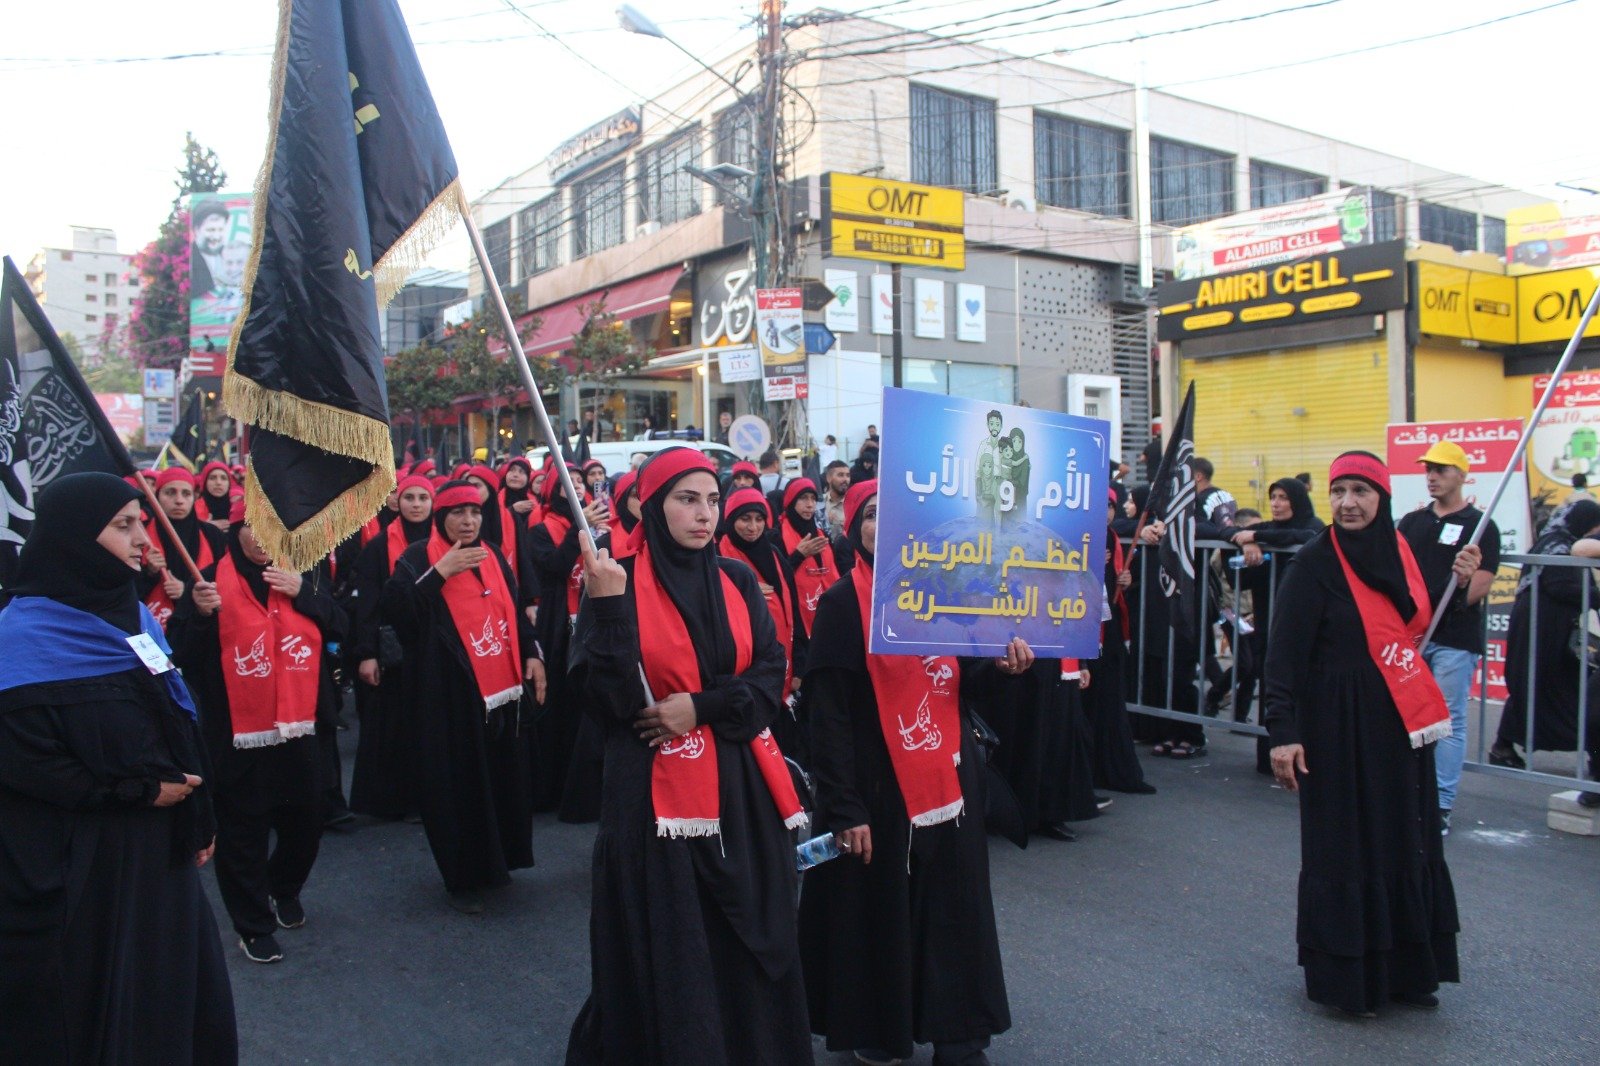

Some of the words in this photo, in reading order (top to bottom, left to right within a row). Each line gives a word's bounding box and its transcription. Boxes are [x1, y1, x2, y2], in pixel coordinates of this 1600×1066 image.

[868, 185, 929, 215] OMT
[1225, 239, 1283, 262] ALAMIRI
[1287, 231, 1322, 249] CELL
[1195, 270, 1268, 308] AMIRI
[1272, 257, 1349, 295] CELL
[1424, 287, 1461, 313] OMT
[1533, 287, 1600, 323] OM
[905, 443, 970, 502] الأب
[999, 479, 1017, 512] و
[901, 532, 992, 571] المربين
[1001, 532, 1091, 578] أعظم
[897, 580, 1038, 624] البشرية
[1047, 590, 1087, 625] في
